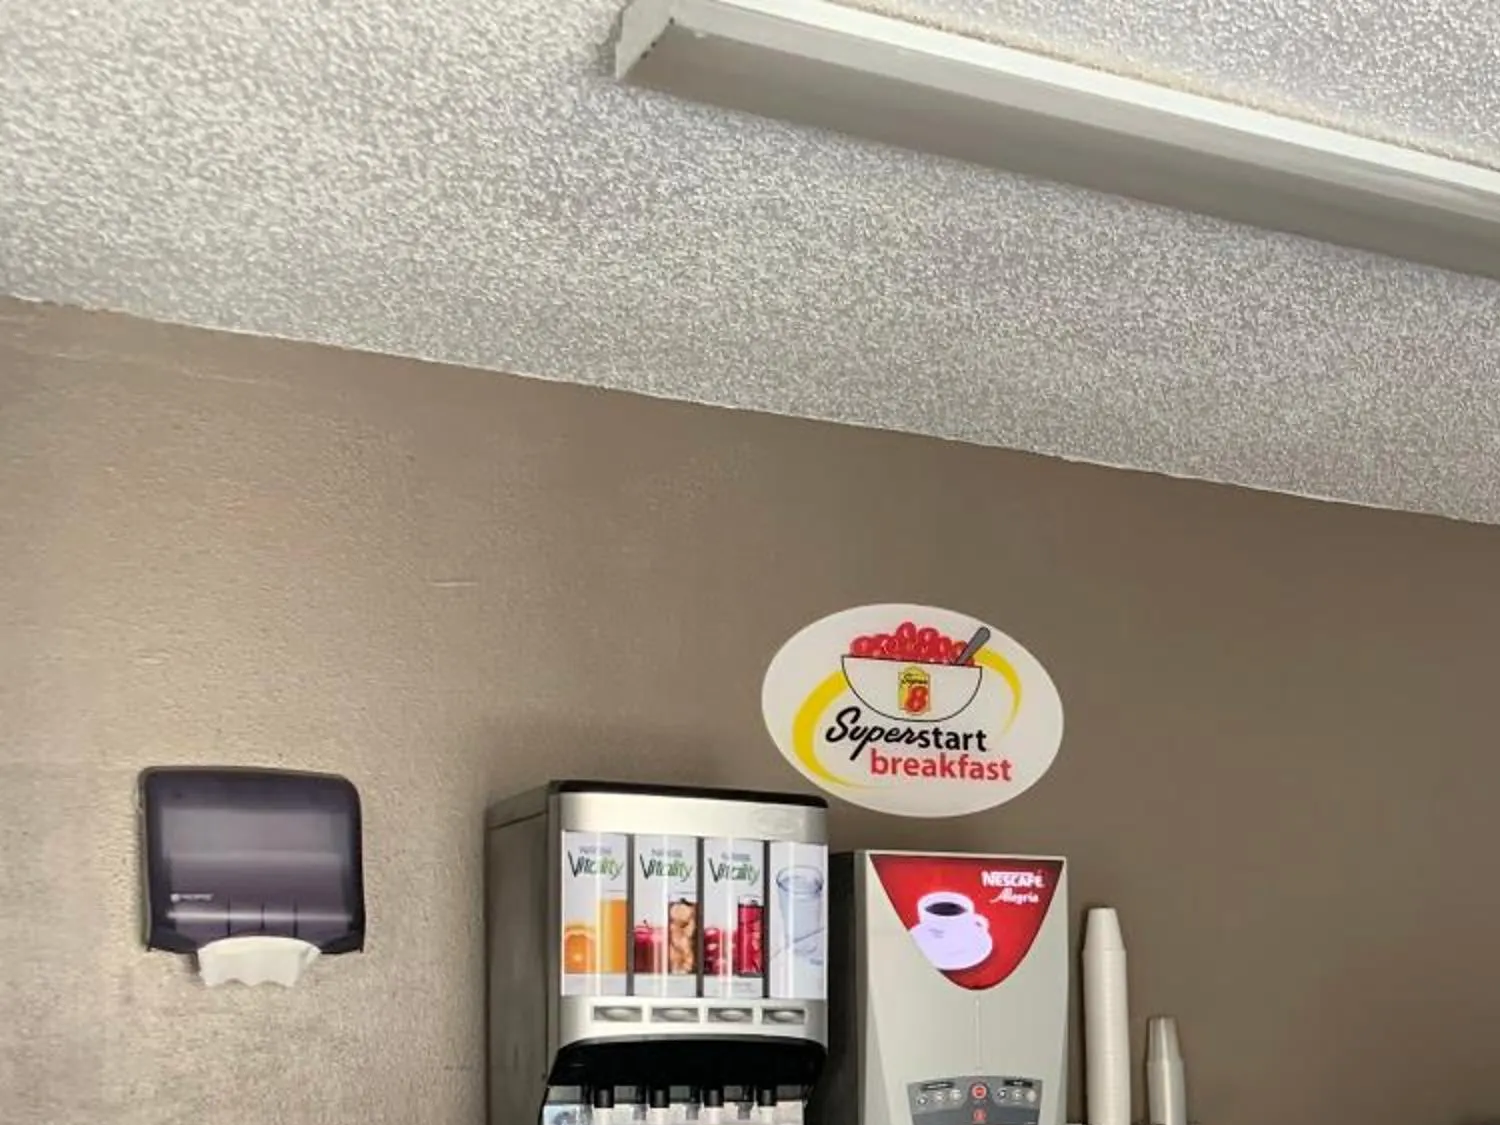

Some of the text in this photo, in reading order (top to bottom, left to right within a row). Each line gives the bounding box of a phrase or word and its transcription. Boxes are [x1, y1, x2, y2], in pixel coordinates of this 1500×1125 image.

[904, 685, 929, 713] 8
[825, 706, 988, 762] Superstart
[871, 748, 1014, 782] breakfast
